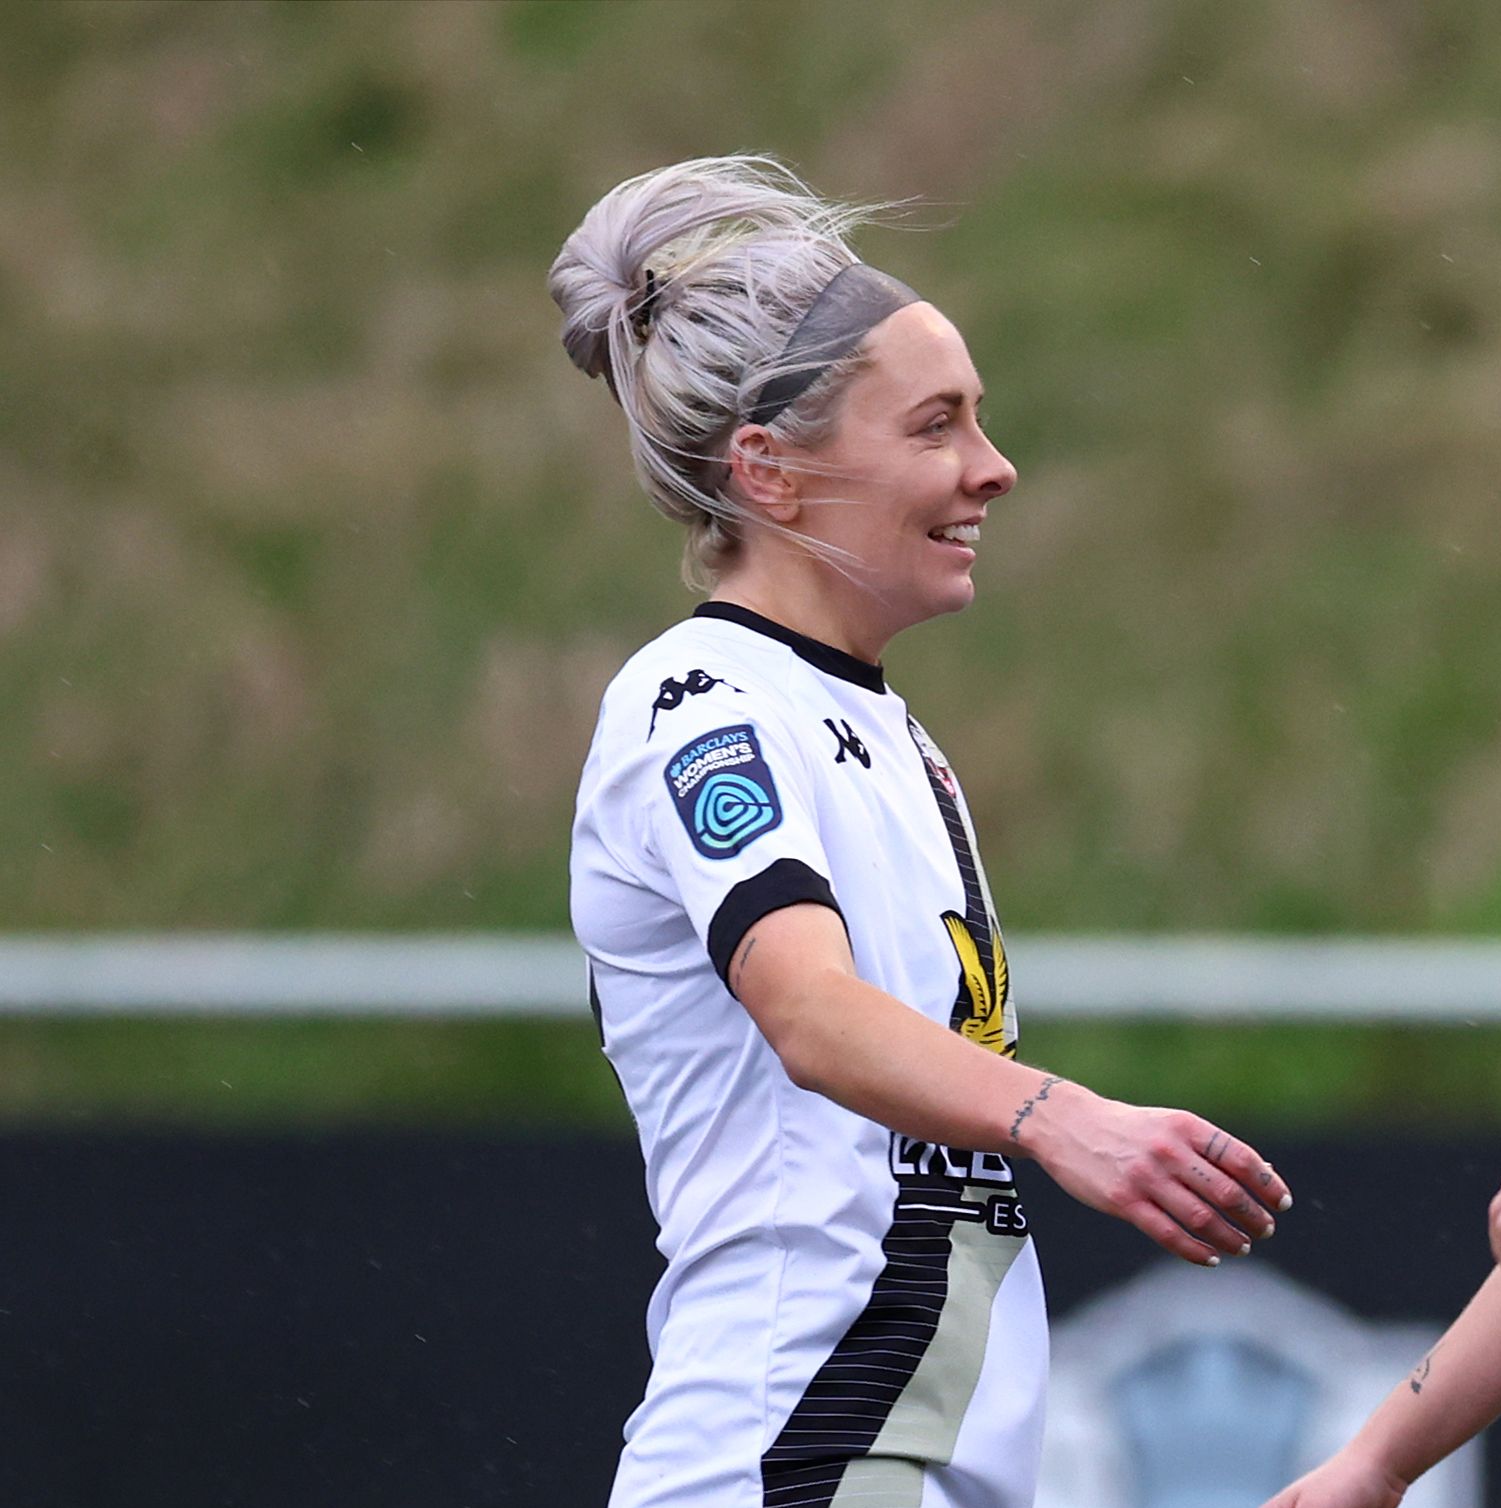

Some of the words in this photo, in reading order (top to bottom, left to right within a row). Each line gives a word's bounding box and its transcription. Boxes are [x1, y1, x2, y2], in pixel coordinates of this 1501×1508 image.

[674, 742, 753, 789] WOMEN'S
[681, 731, 750, 768] BARCLAYS
[678, 753, 756, 798] CHAMPIONSHIP
